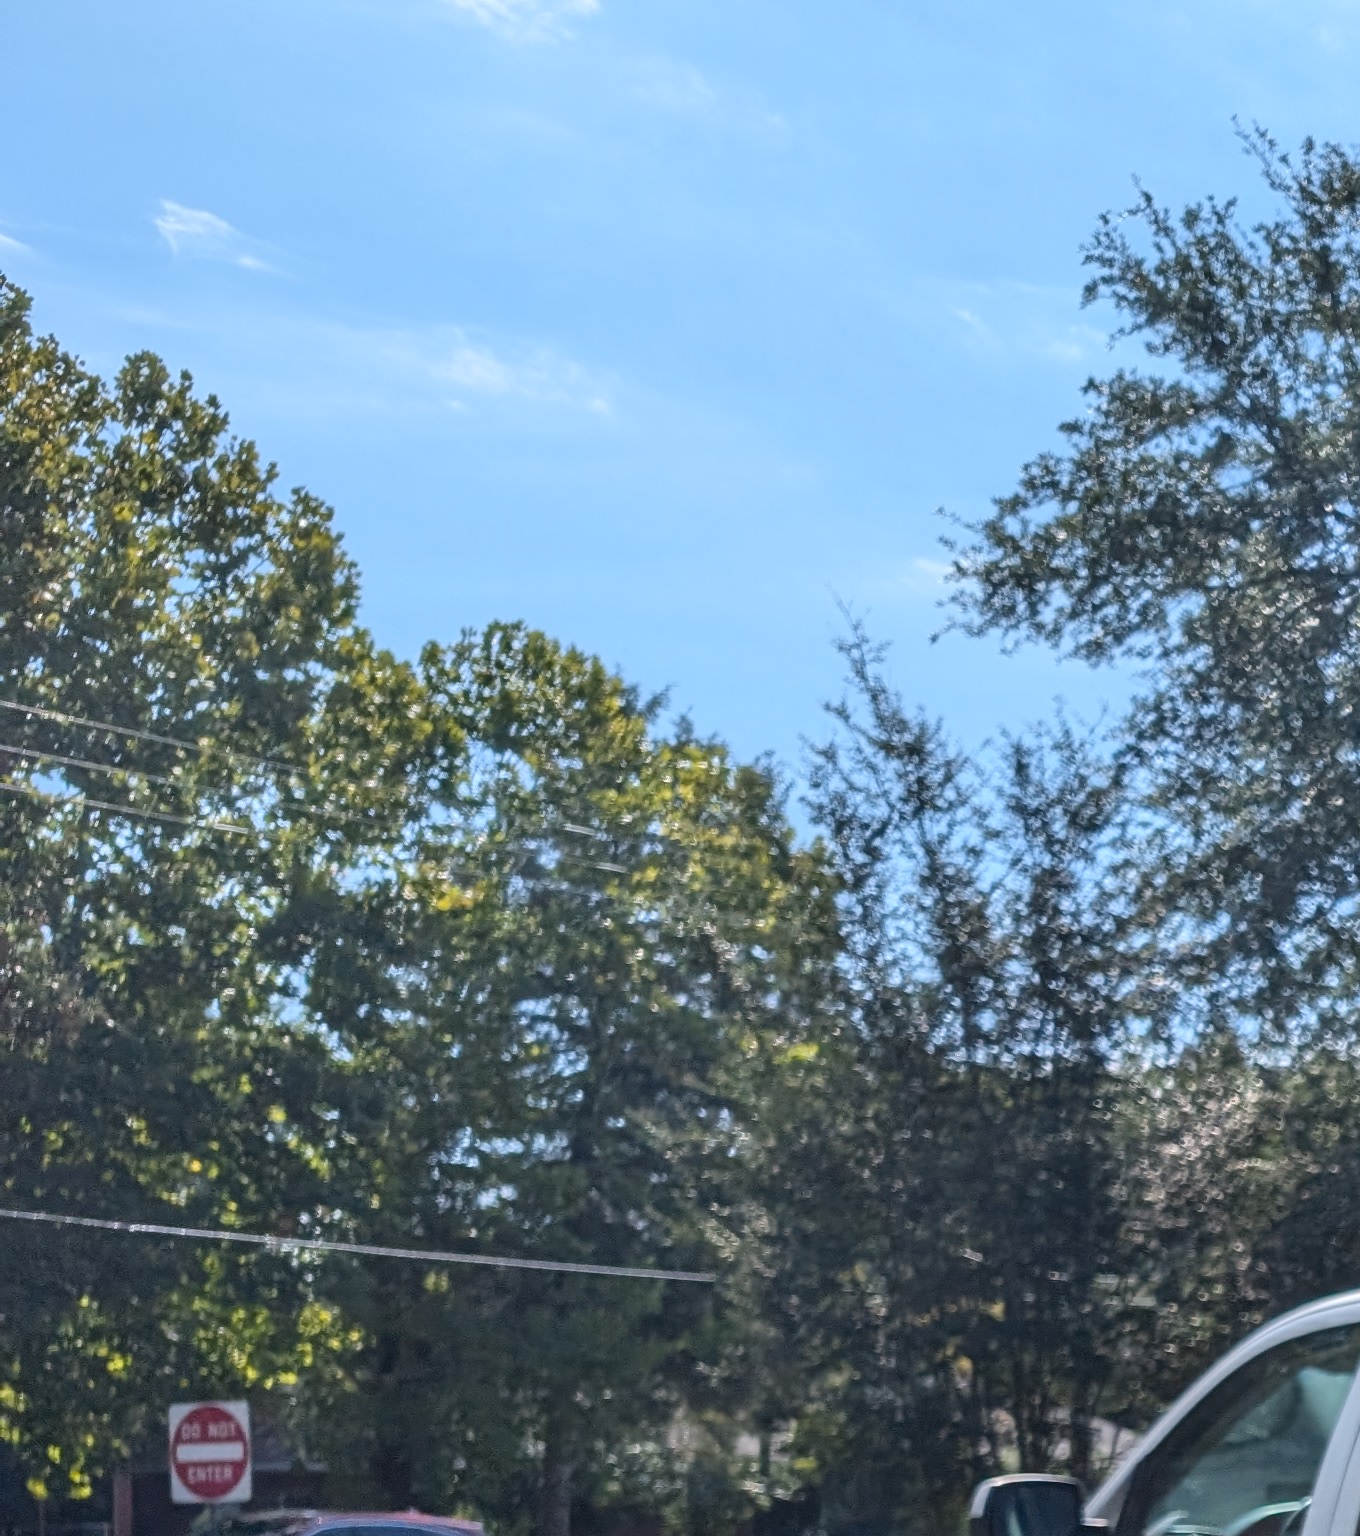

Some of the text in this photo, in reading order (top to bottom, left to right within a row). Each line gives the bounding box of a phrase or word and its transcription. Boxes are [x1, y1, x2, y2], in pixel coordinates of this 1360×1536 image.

[181, 1420, 236, 1441] DO NOT
[187, 1464, 233, 1484] ENTER
